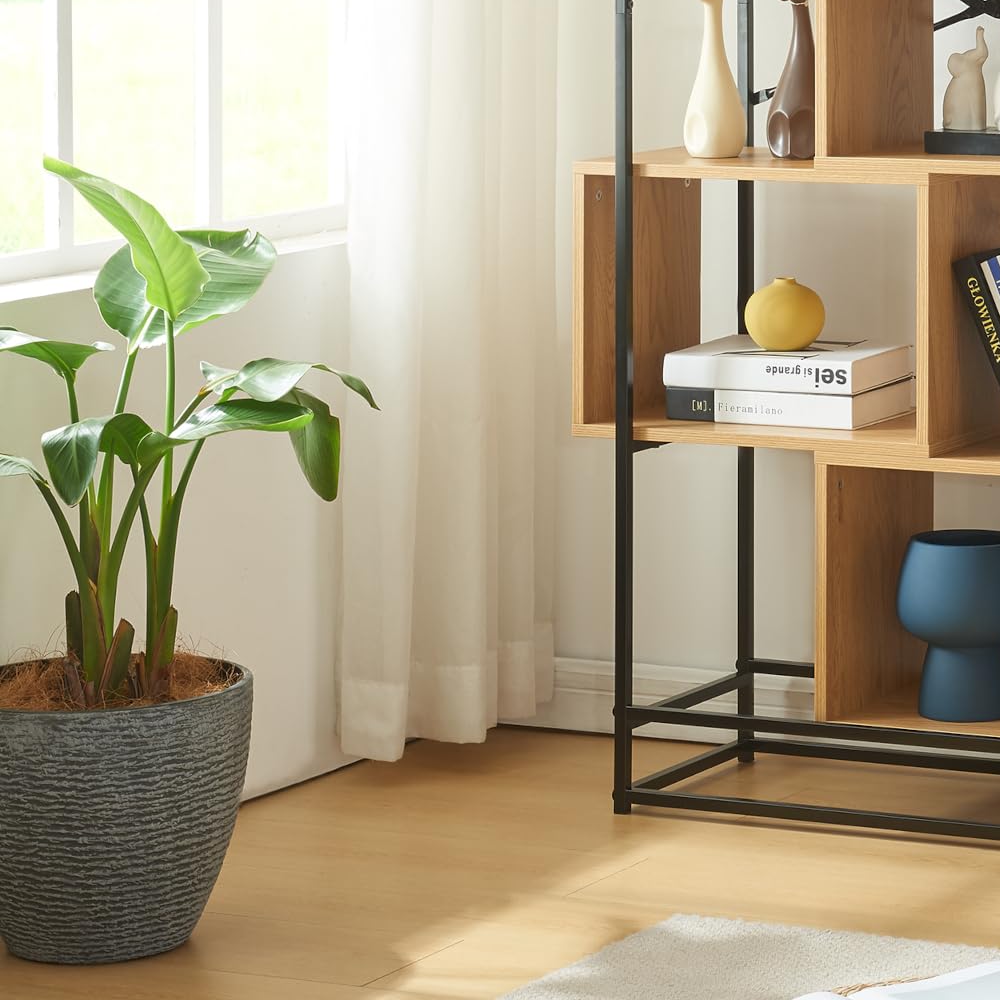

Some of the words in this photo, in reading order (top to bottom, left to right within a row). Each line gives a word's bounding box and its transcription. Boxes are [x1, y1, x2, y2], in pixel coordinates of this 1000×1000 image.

[765, 365, 801, 376] grande
[803, 367, 813, 378] si
[814, 367, 848, 388] sei
[718, 402, 783, 415] Fieramilano
